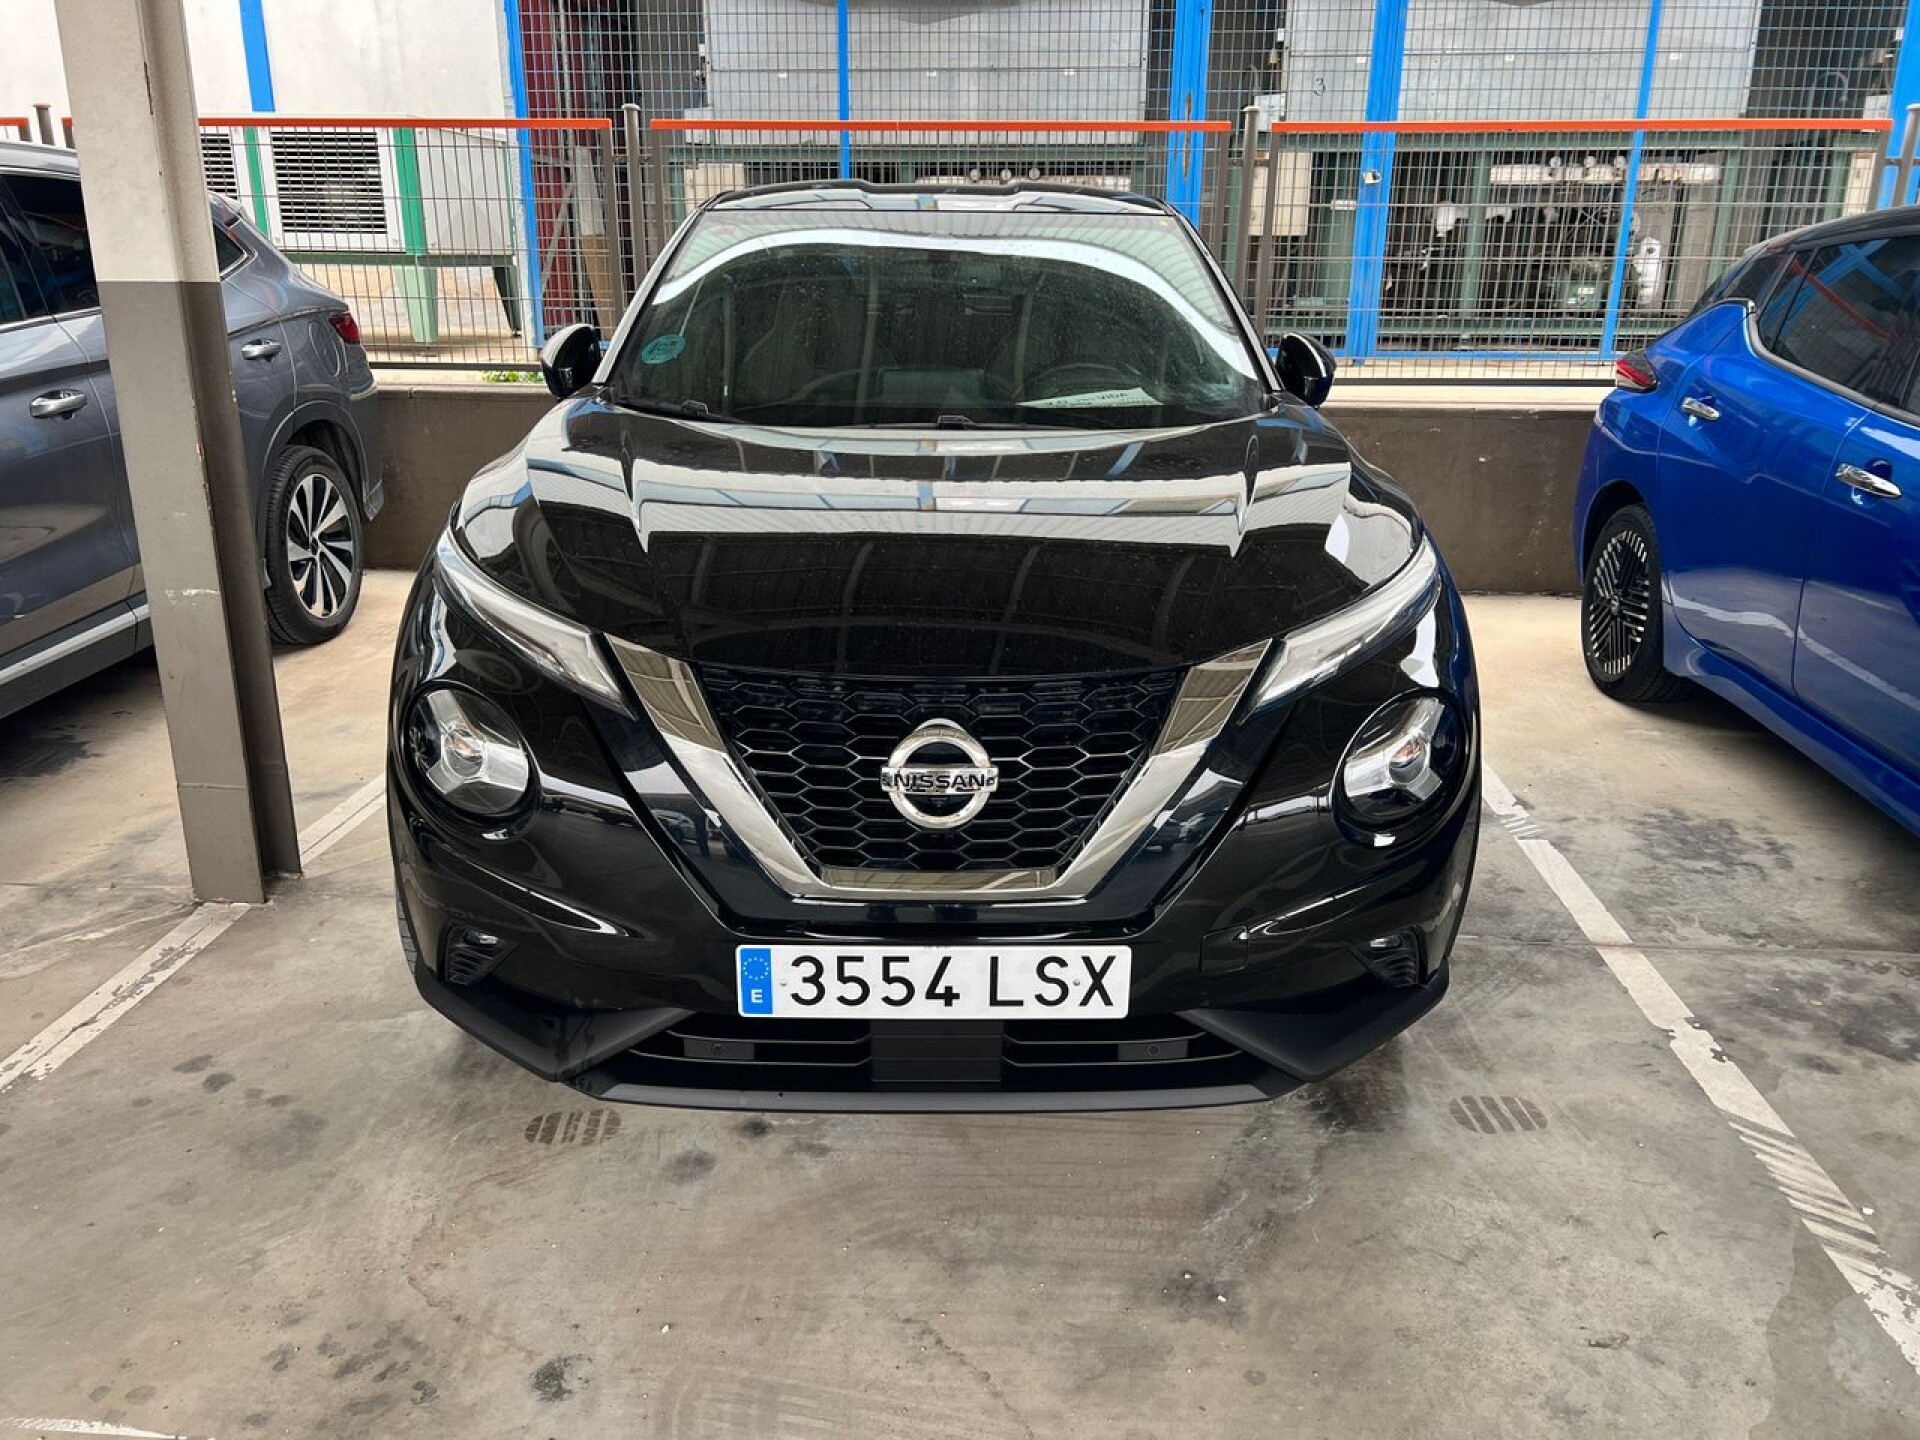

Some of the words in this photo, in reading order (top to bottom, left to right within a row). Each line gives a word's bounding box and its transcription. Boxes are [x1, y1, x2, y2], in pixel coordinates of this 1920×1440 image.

[1313, 77, 1327, 97] 3
[893, 773, 985, 789] NISSAN
[790, 955, 961, 1008] 3554
[989, 955, 1117, 1008] LSX
[750, 989, 763, 1003] E
